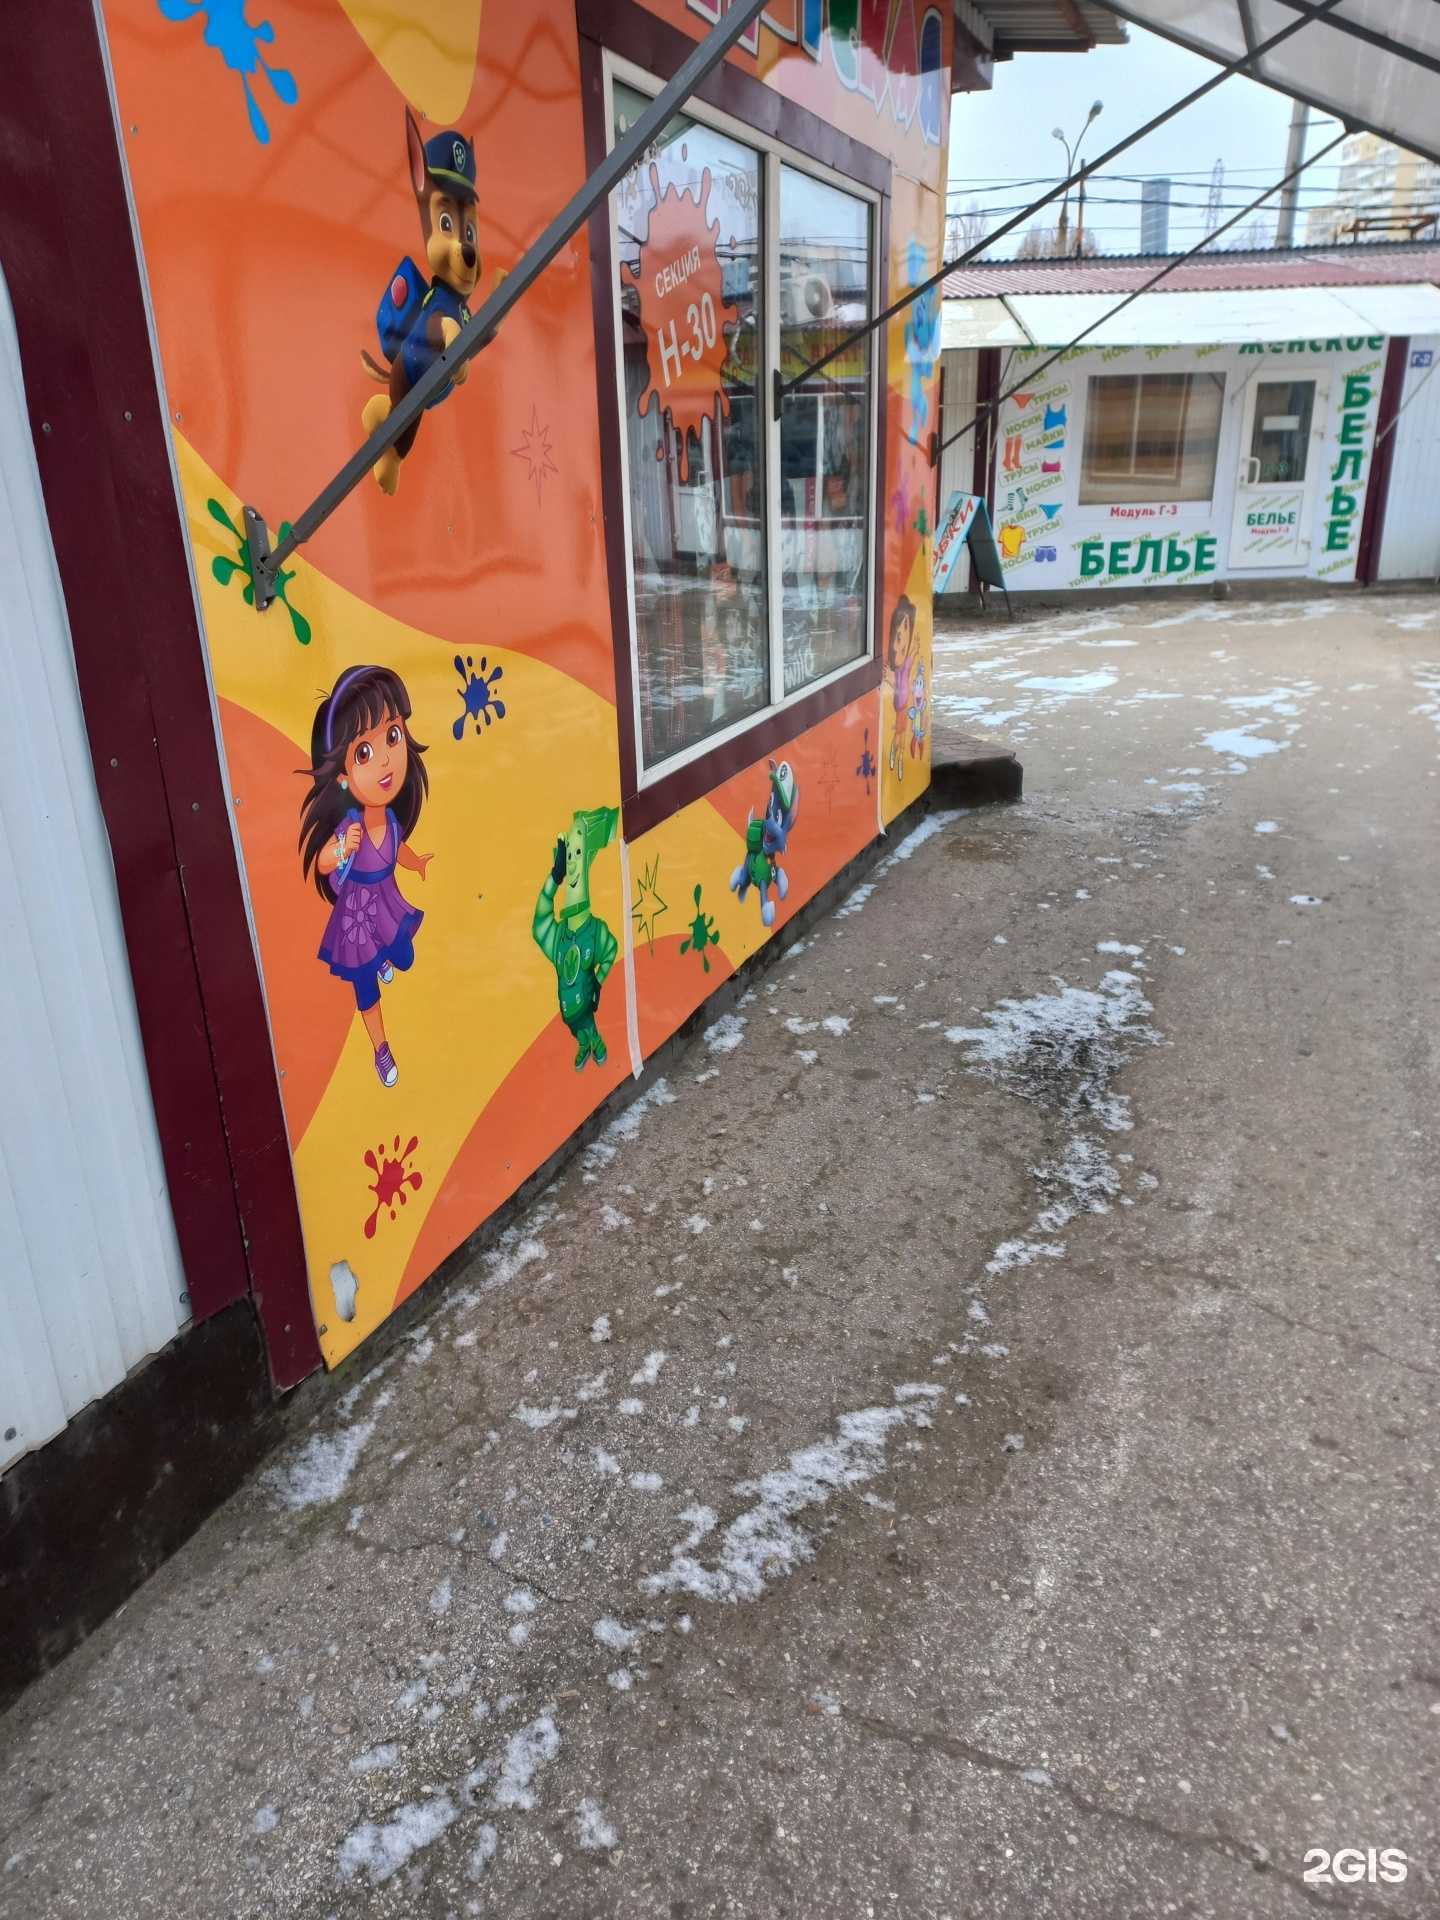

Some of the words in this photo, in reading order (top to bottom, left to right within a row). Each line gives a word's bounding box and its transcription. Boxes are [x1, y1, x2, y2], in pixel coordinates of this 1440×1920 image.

[655, 245, 701, 298] СЕКЦИЯ
[657, 292, 717, 388] Н-30
[1327, 375, 1372, 551] БЕЛЬЕ
[1110, 506, 1156, 519] Модуль
[1159, 504, 1178, 516] Г-3
[1245, 512, 1297, 526] БЕЛЬЕ
[1079, 537, 1218, 577] БЕЛЬЕ
